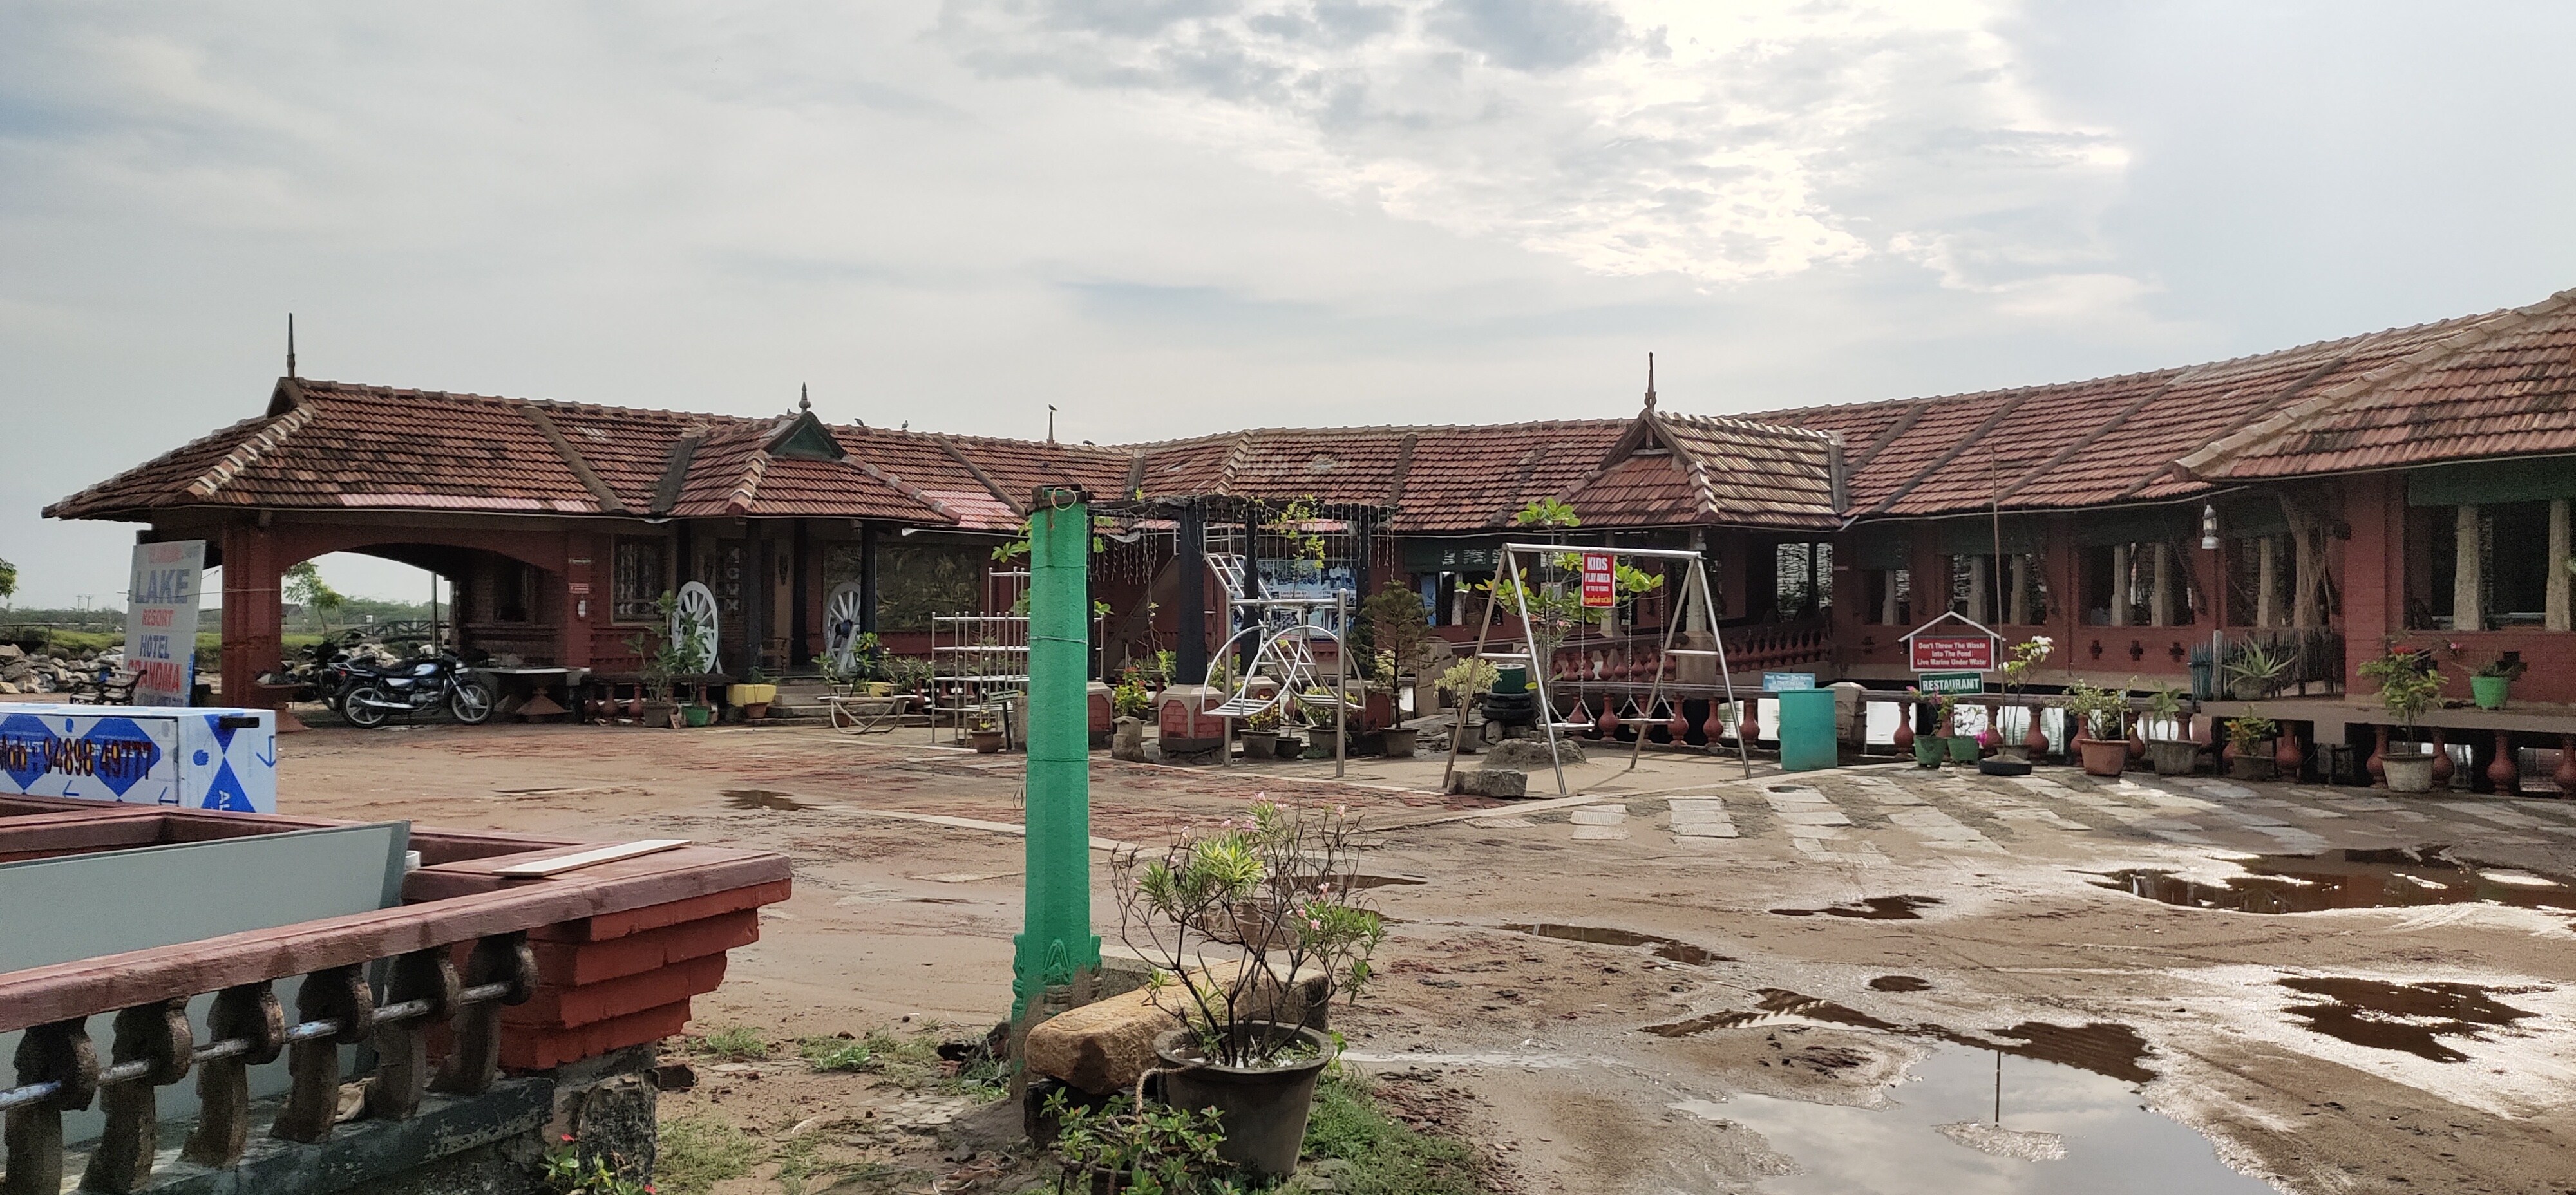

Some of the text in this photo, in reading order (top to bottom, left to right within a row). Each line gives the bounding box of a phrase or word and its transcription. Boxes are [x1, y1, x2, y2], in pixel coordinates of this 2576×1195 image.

[1587, 556, 1608, 571] KIDS
[135, 569, 191, 604] LAKE
[1584, 572, 1611, 583] PLAY AREA
[142, 608, 175, 627] RESORT
[139, 634, 170, 659] HOTEL
[1922, 677, 1980, 691] RESTAURANT
[43, 736, 94, 776] 94898
[100, 739, 153, 780] 49777
